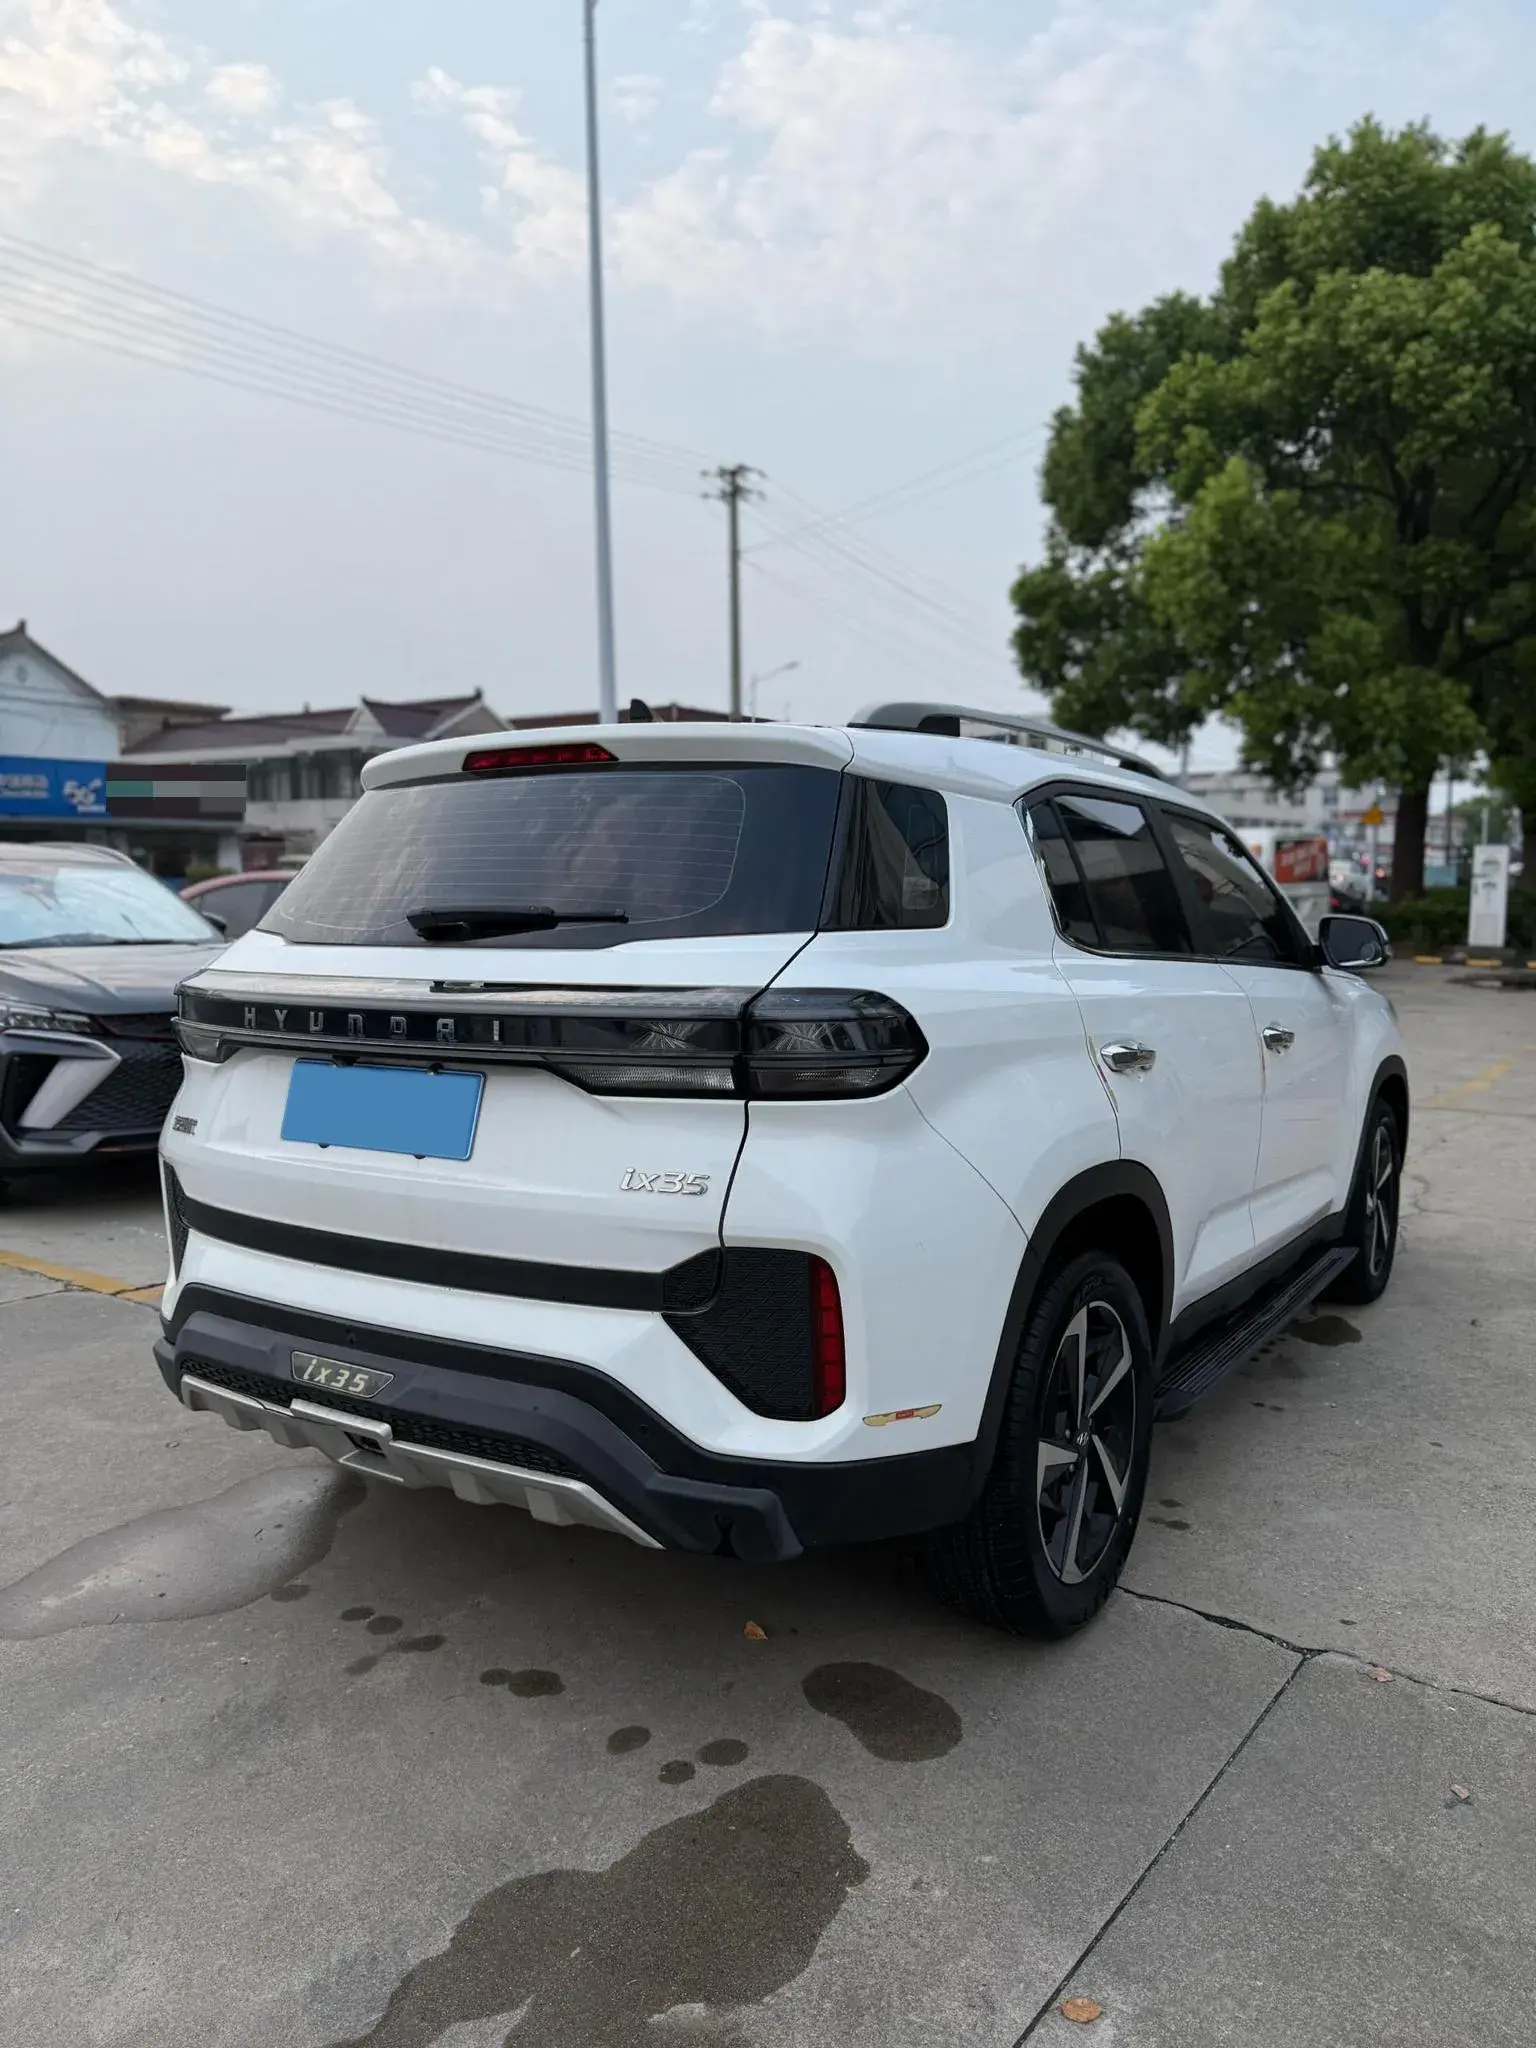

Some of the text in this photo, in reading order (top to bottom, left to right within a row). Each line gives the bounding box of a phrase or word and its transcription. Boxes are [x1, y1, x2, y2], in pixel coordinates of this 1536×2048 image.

[244, 1006, 500, 1042] HYUNDAI
[620, 1167, 711, 1196] ix35
[303, 1358, 370, 1393] ix35
